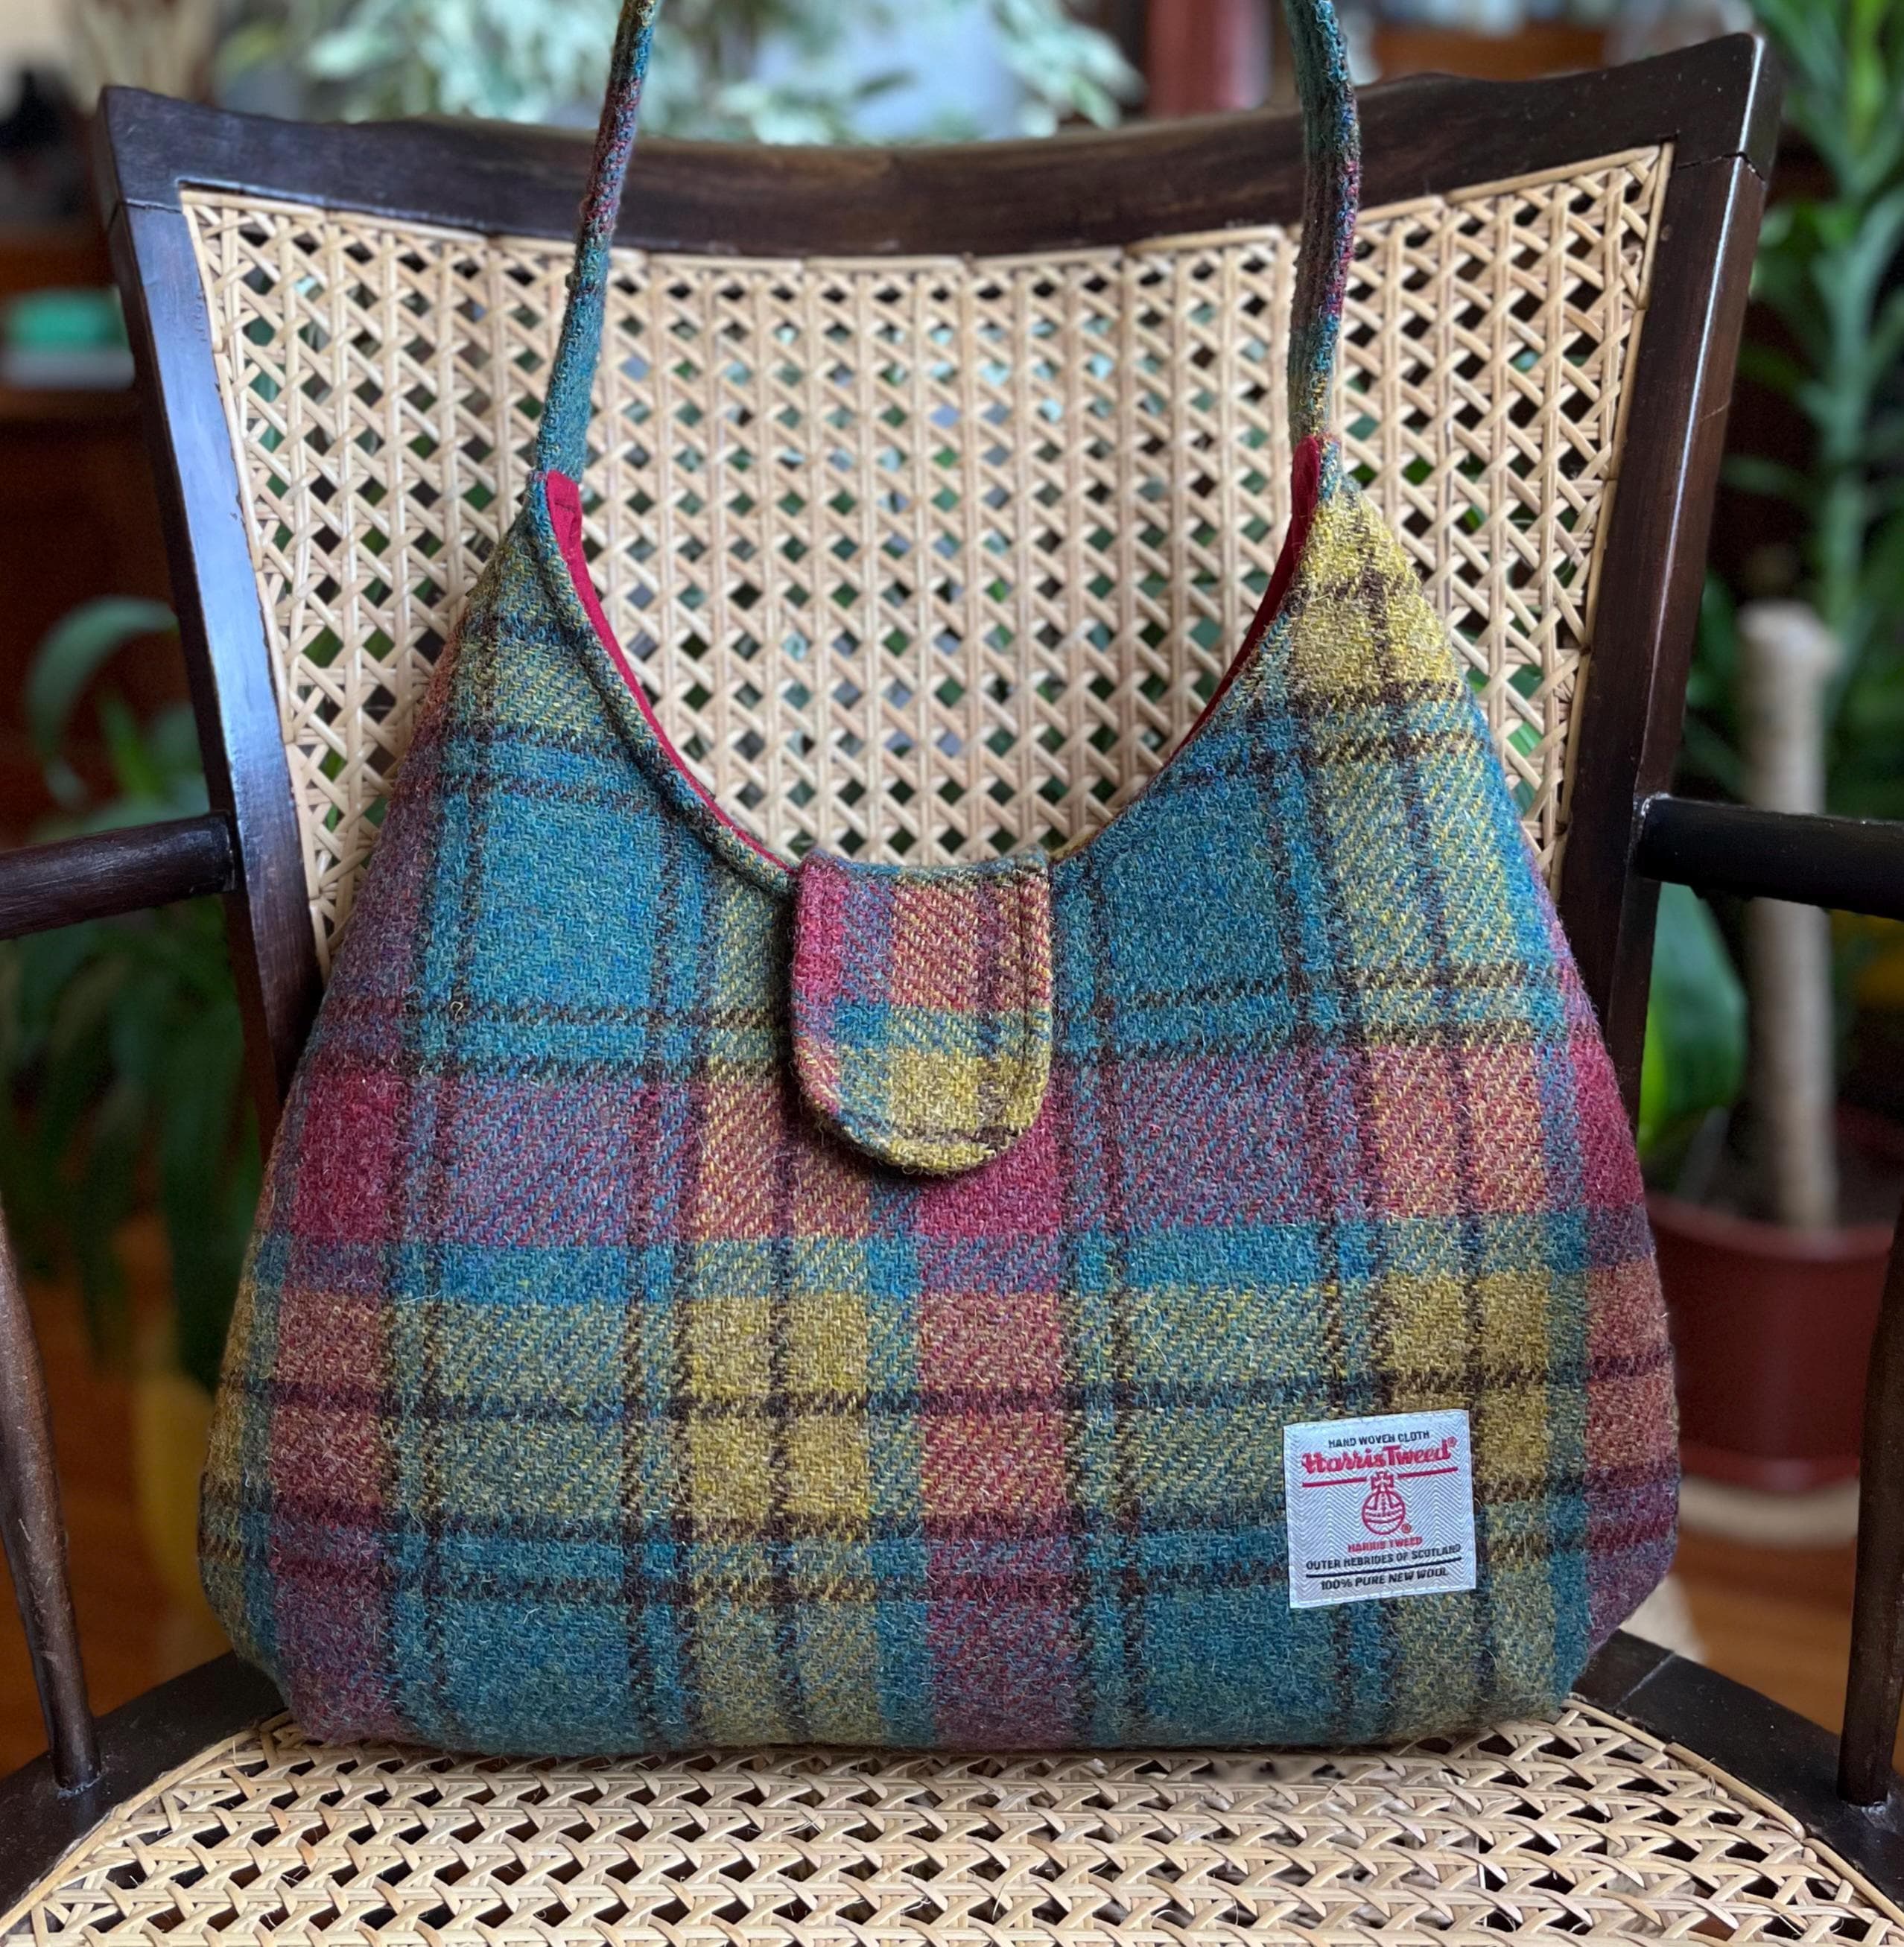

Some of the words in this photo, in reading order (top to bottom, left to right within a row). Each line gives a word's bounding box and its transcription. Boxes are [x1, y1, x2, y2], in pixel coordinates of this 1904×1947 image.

[1329, 1438, 1356, 1448] HAND
[1359, 1433, 1395, 1444] WOVEN
[1398, 1430, 1429, 1442] CLOTH
[1348, 1541, 1386, 1552] HARRIS
[1389, 1537, 1422, 1548] TWEED
[1307, 1560, 1340, 1570] OUTER
[1344, 1554, 1393, 1566] HEBRIDES
[1397, 1552, 1407, 1560] OF
[1412, 1544, 1461, 1559] SCOTLAND
[1321, 1578, 1352, 1589] 100%
[1356, 1575, 1385, 1586] PURE
[1389, 1572, 1414, 1583] NEW
[1417, 1569, 1447, 1579] WOOL
